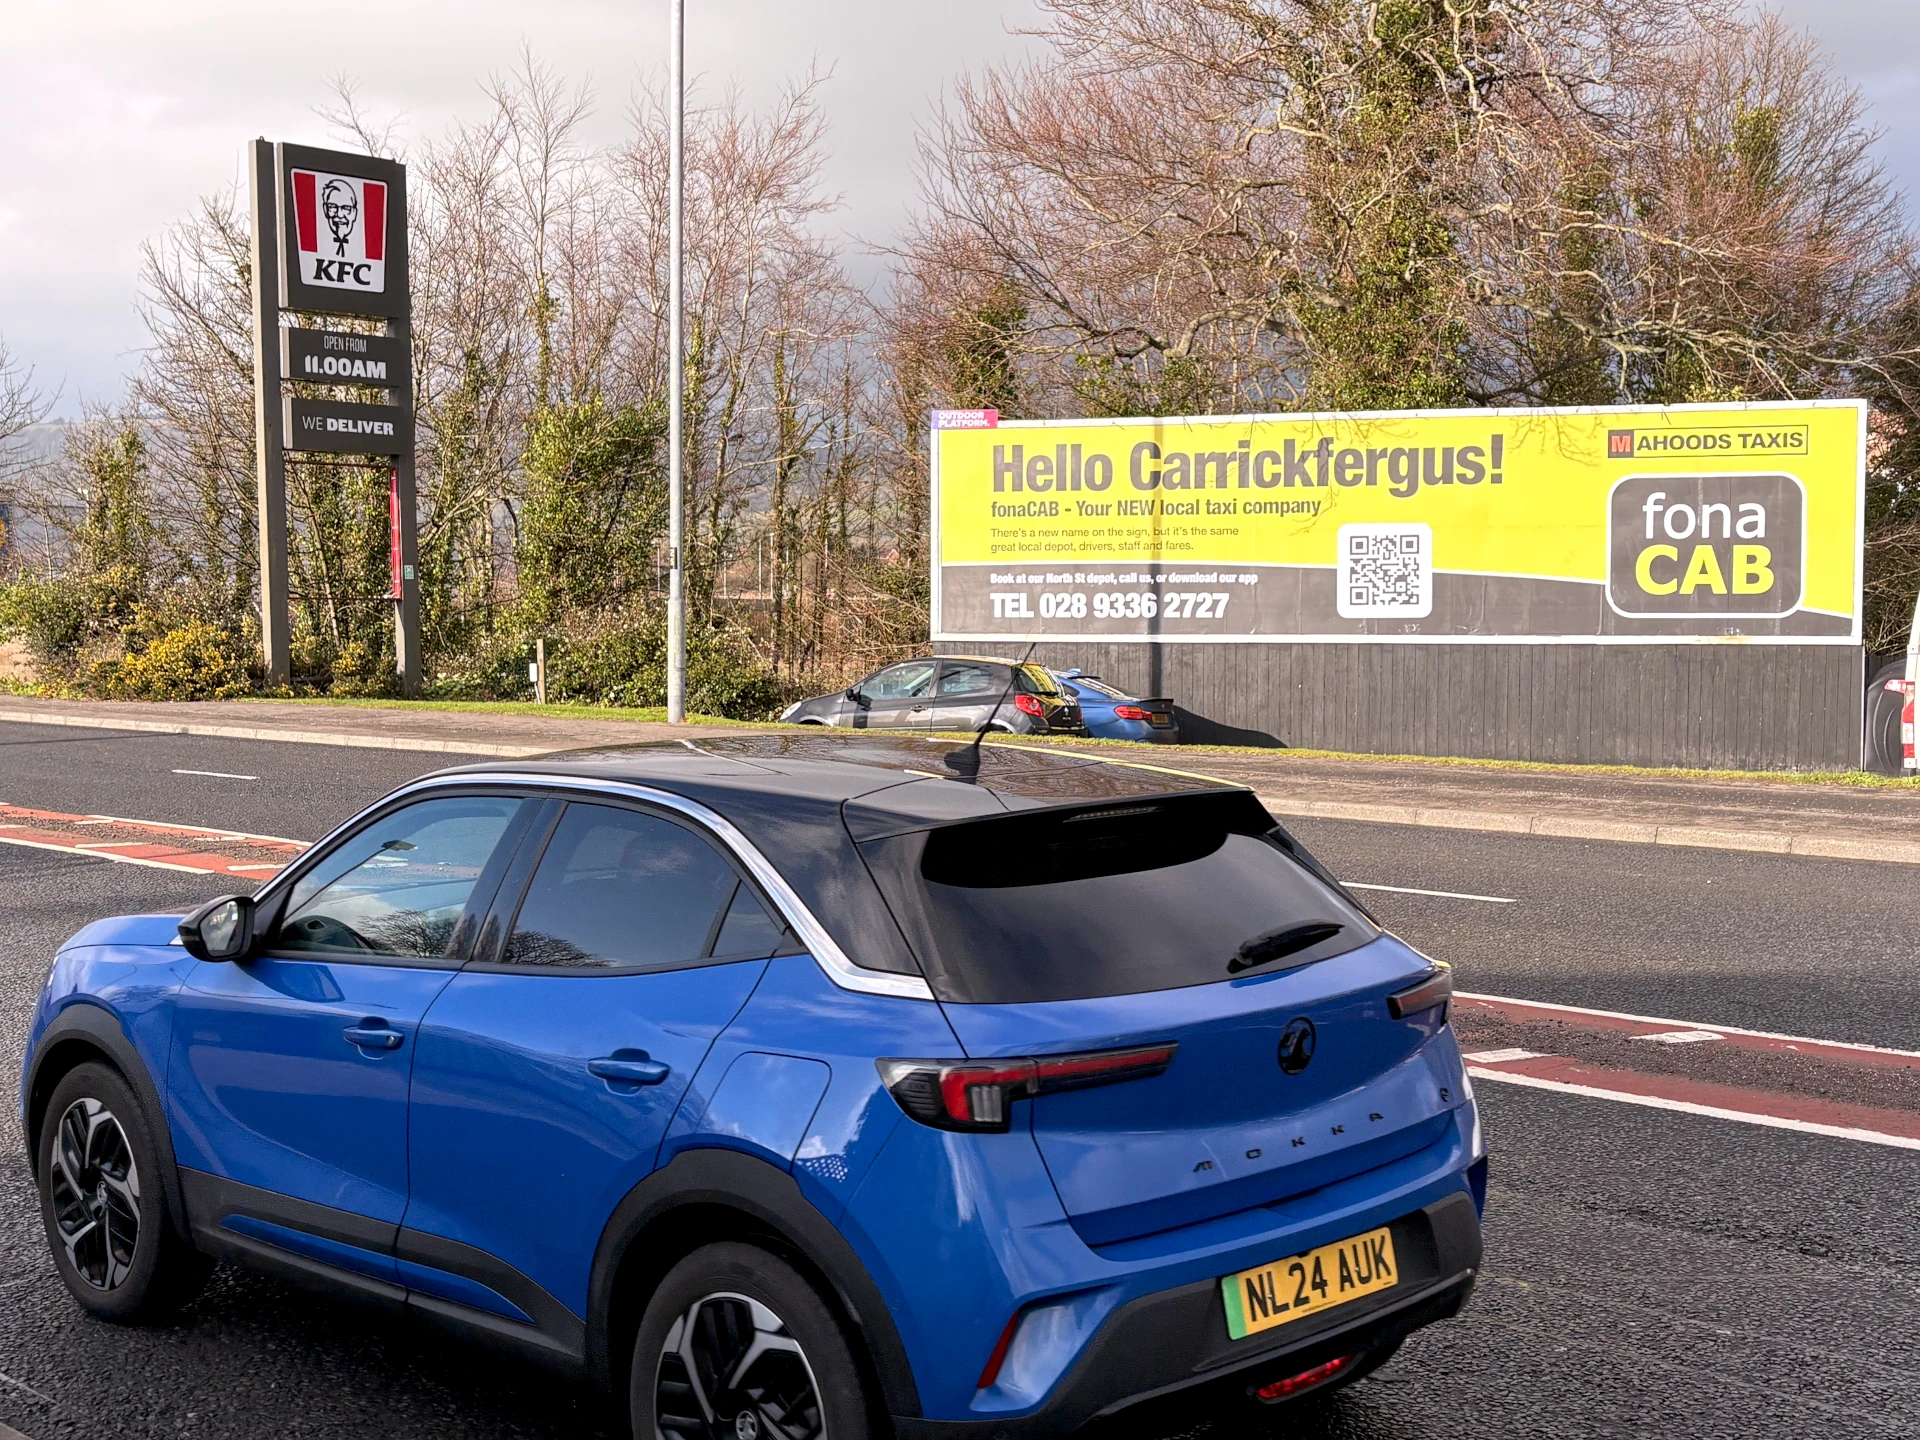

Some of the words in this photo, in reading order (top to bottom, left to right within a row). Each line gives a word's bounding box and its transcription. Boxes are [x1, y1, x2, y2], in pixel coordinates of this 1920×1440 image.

[313, 258, 372, 286] KFC
[323, 335, 345, 352] OPEN
[345, 337, 367, 353] FROM
[304, 355, 387, 379] 11.00AM
[302, 415, 323, 431] WE
[326, 417, 394, 436] DELIVER
[938, 411, 985, 419] OUTDOOR
[1738, 432, 1804, 449] TAXIS
[993, 443, 1113, 492] Hello
[1130, 434, 1504, 497] Carrickfergus!
[991, 501, 1059, 517] fonaCAB
[1076, 500, 1112, 516] Your
[1117, 500, 1155, 516] NEW
[1160, 499, 1200, 515] local
[1206, 498, 1237, 514] taxi
[1243, 500, 1321, 517] company
[1642, 492, 1766, 540] fona
[991, 528, 1027, 538] There's
[1029, 529, 1036, 537] a
[1038, 529, 1058, 537] new
[1061, 529, 1089, 537] name
[1107, 527, 1124, 536] the
[1126, 527, 1150, 538] sign,
[1153, 526, 1170, 536] but
[1173, 526, 1188, 536] it's
[1191, 526, 1207, 536] the
[1210, 528, 1239, 536] same
[991, 542, 1016, 553] great
[1018, 542, 1042, 551] local
[1045, 542, 1076, 553] depot,
[1079, 541, 1115, 552] drivers,
[1118, 541, 1141, 550] staff
[1143, 540, 1162, 550] and
[1165, 540, 1194, 550] fares.
[990, 573, 1014, 583] Book
[1016, 574, 1026, 583] at
[1028, 575, 1044, 583] our
[1046, 573, 1073, 583] North
[1075, 574, 1085, 583] St
[1087, 573, 1117, 585] depot,
[1119, 573, 1137, 583] call
[1139, 574, 1154, 584] us,
[1156, 575, 1167, 583] or
[1168, 572, 1217, 583] download
[1219, 575, 1236, 583] our
[1238, 575, 1258, 585] app
[1635, 544, 1775, 596] CAB
[990, 593, 1034, 618] TEL
[1039, 593, 1087, 618] 028
[1093, 593, 1157, 618] 9336
[1163, 592, 1229, 618] 2727
[1339, 1235, 1391, 1292] AUK
